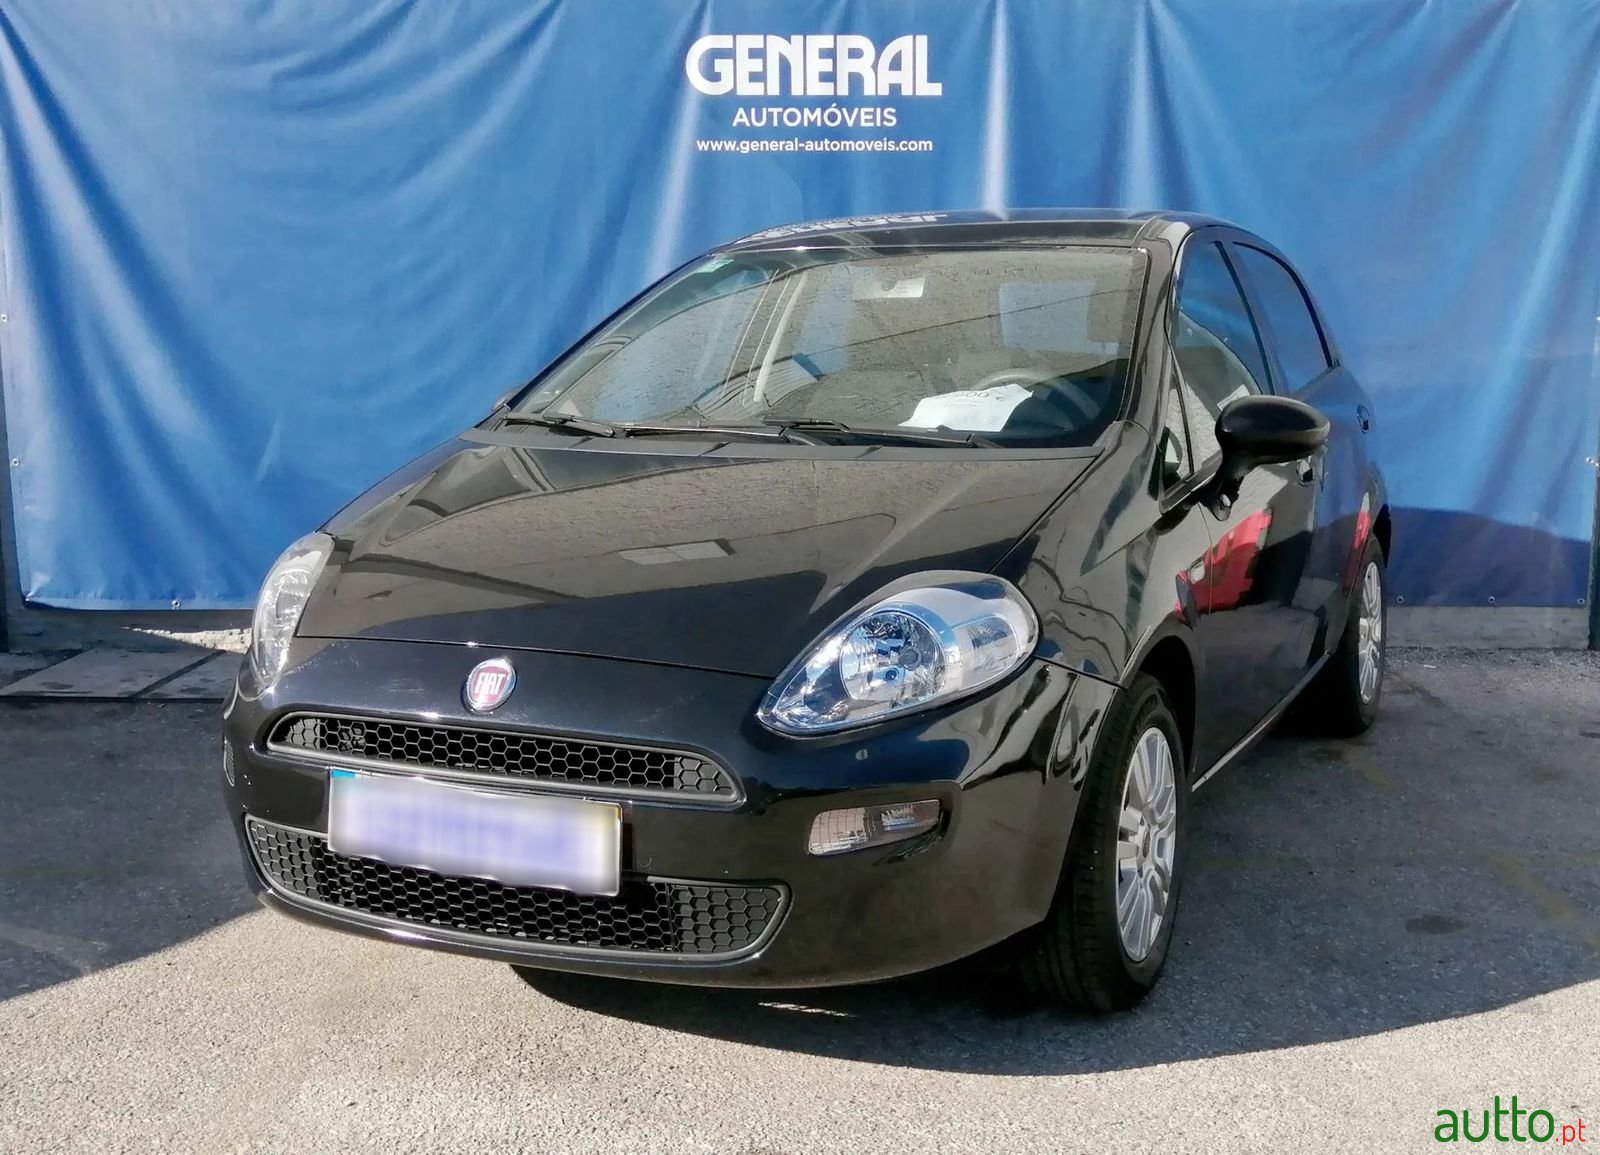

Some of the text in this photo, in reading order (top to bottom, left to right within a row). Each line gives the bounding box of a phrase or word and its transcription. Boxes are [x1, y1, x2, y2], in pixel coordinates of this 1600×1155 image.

[686, 35, 942, 96] GENERAL
[732, 103, 897, 127] AUTOMÓVEIS
[697, 138, 933, 153] www.general-automoveis.com
[474, 672, 506, 695] FIAT
